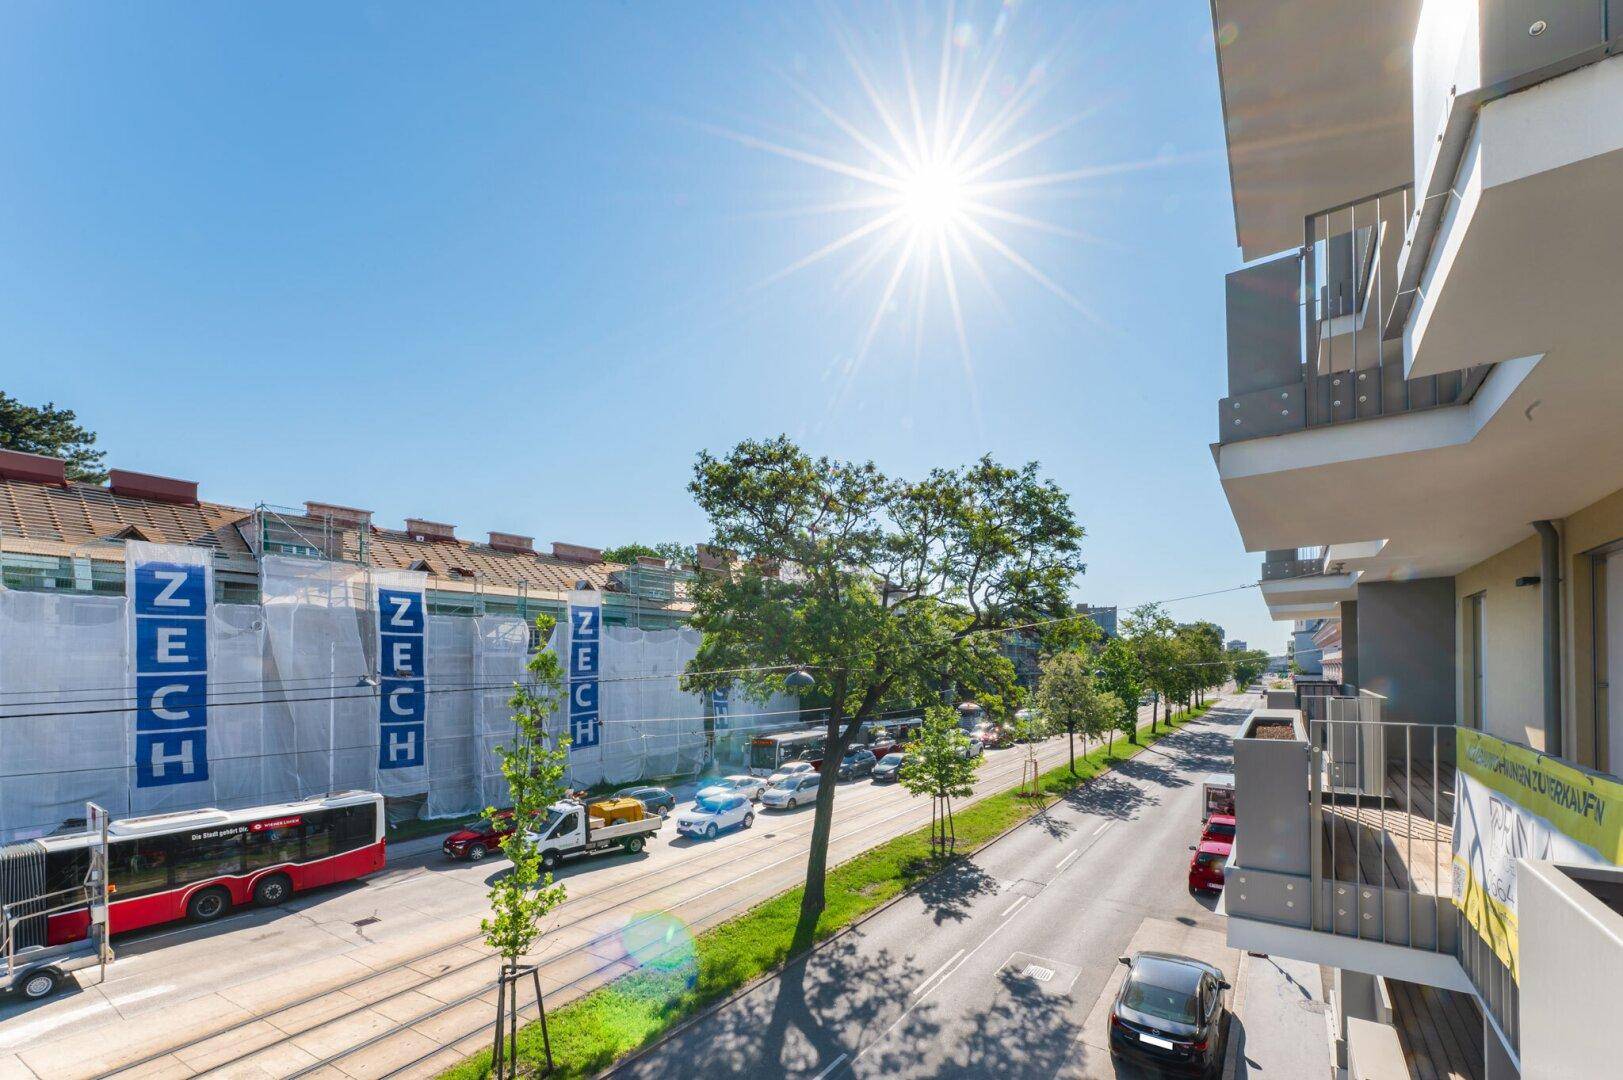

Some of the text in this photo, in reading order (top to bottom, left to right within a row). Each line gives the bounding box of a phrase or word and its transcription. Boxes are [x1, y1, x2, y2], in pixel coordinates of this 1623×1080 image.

[151, 571, 195, 777] ZECH
[389, 597, 415, 762] ZECH
[576, 611, 594, 745] ZECH
[202, 831, 219, 839] Stadt
[219, 828, 238, 838] gehört
